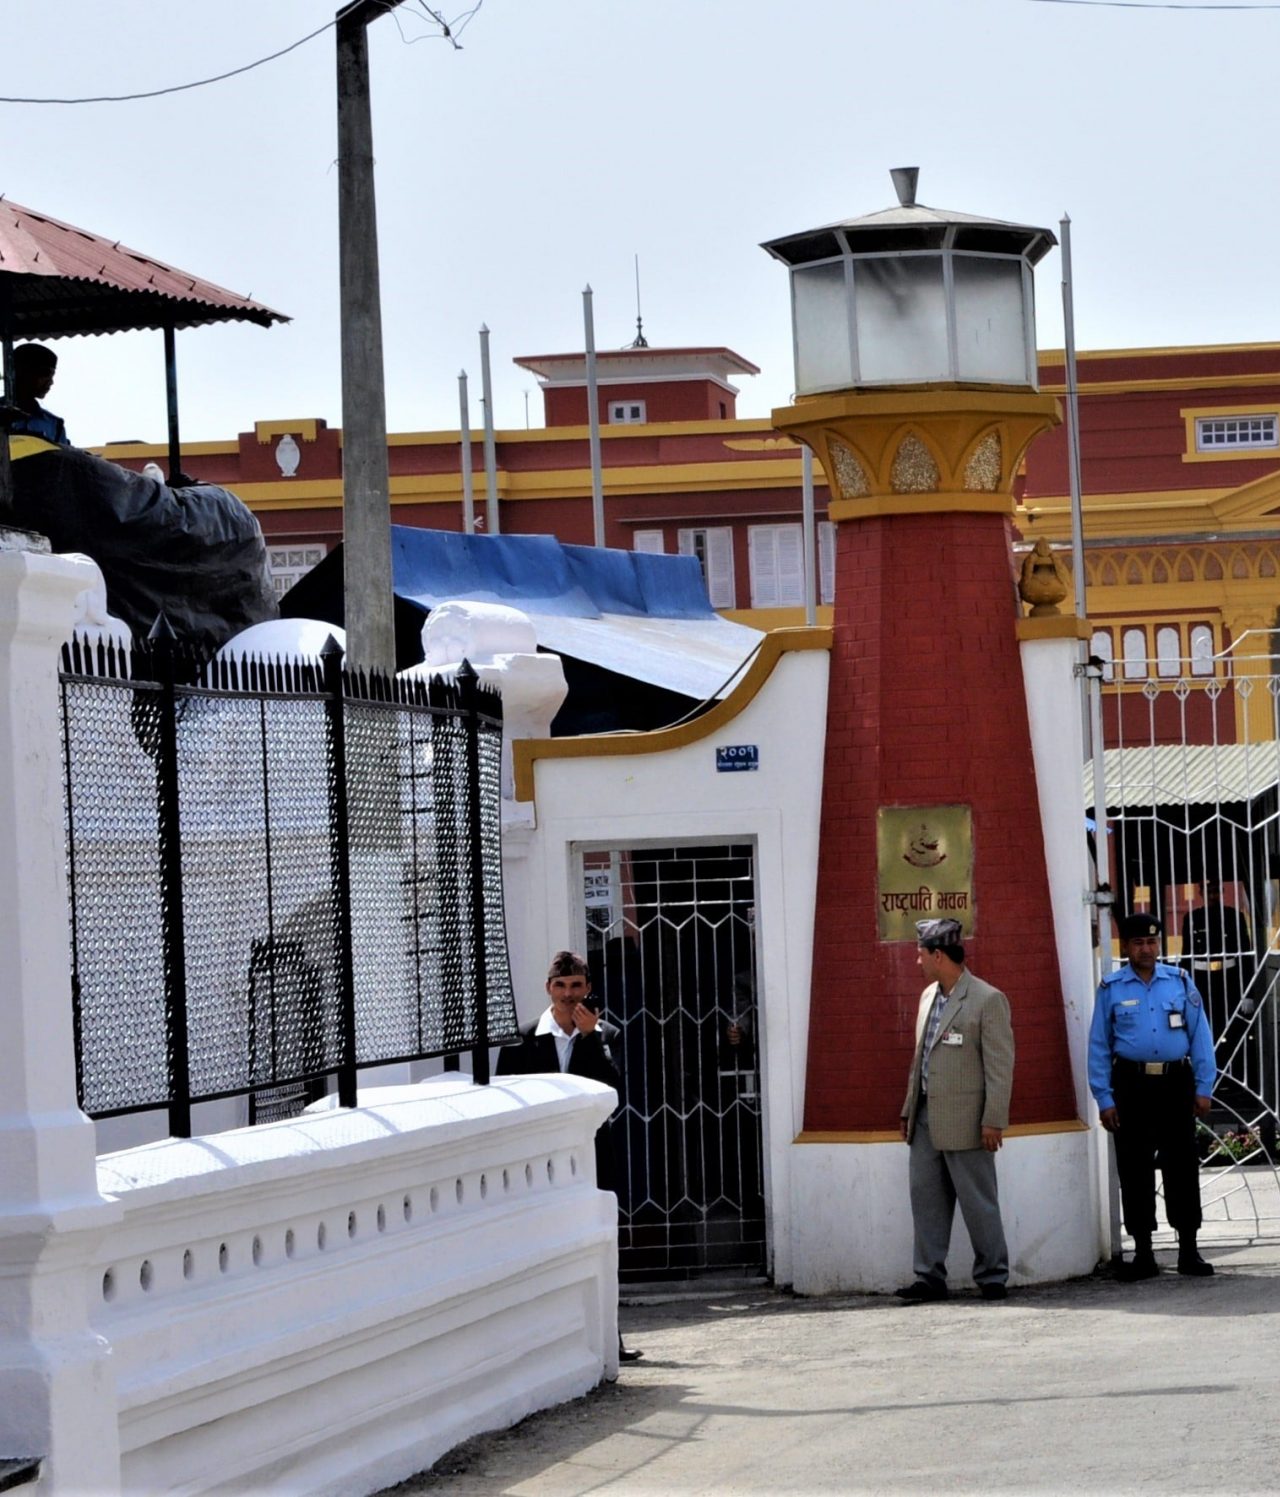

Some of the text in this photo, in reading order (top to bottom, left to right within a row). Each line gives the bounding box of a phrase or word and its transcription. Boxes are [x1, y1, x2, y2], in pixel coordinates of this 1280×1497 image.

[720, 745, 755, 760] २००१
[881, 886, 969, 917] राष्ट्रपति भवन
